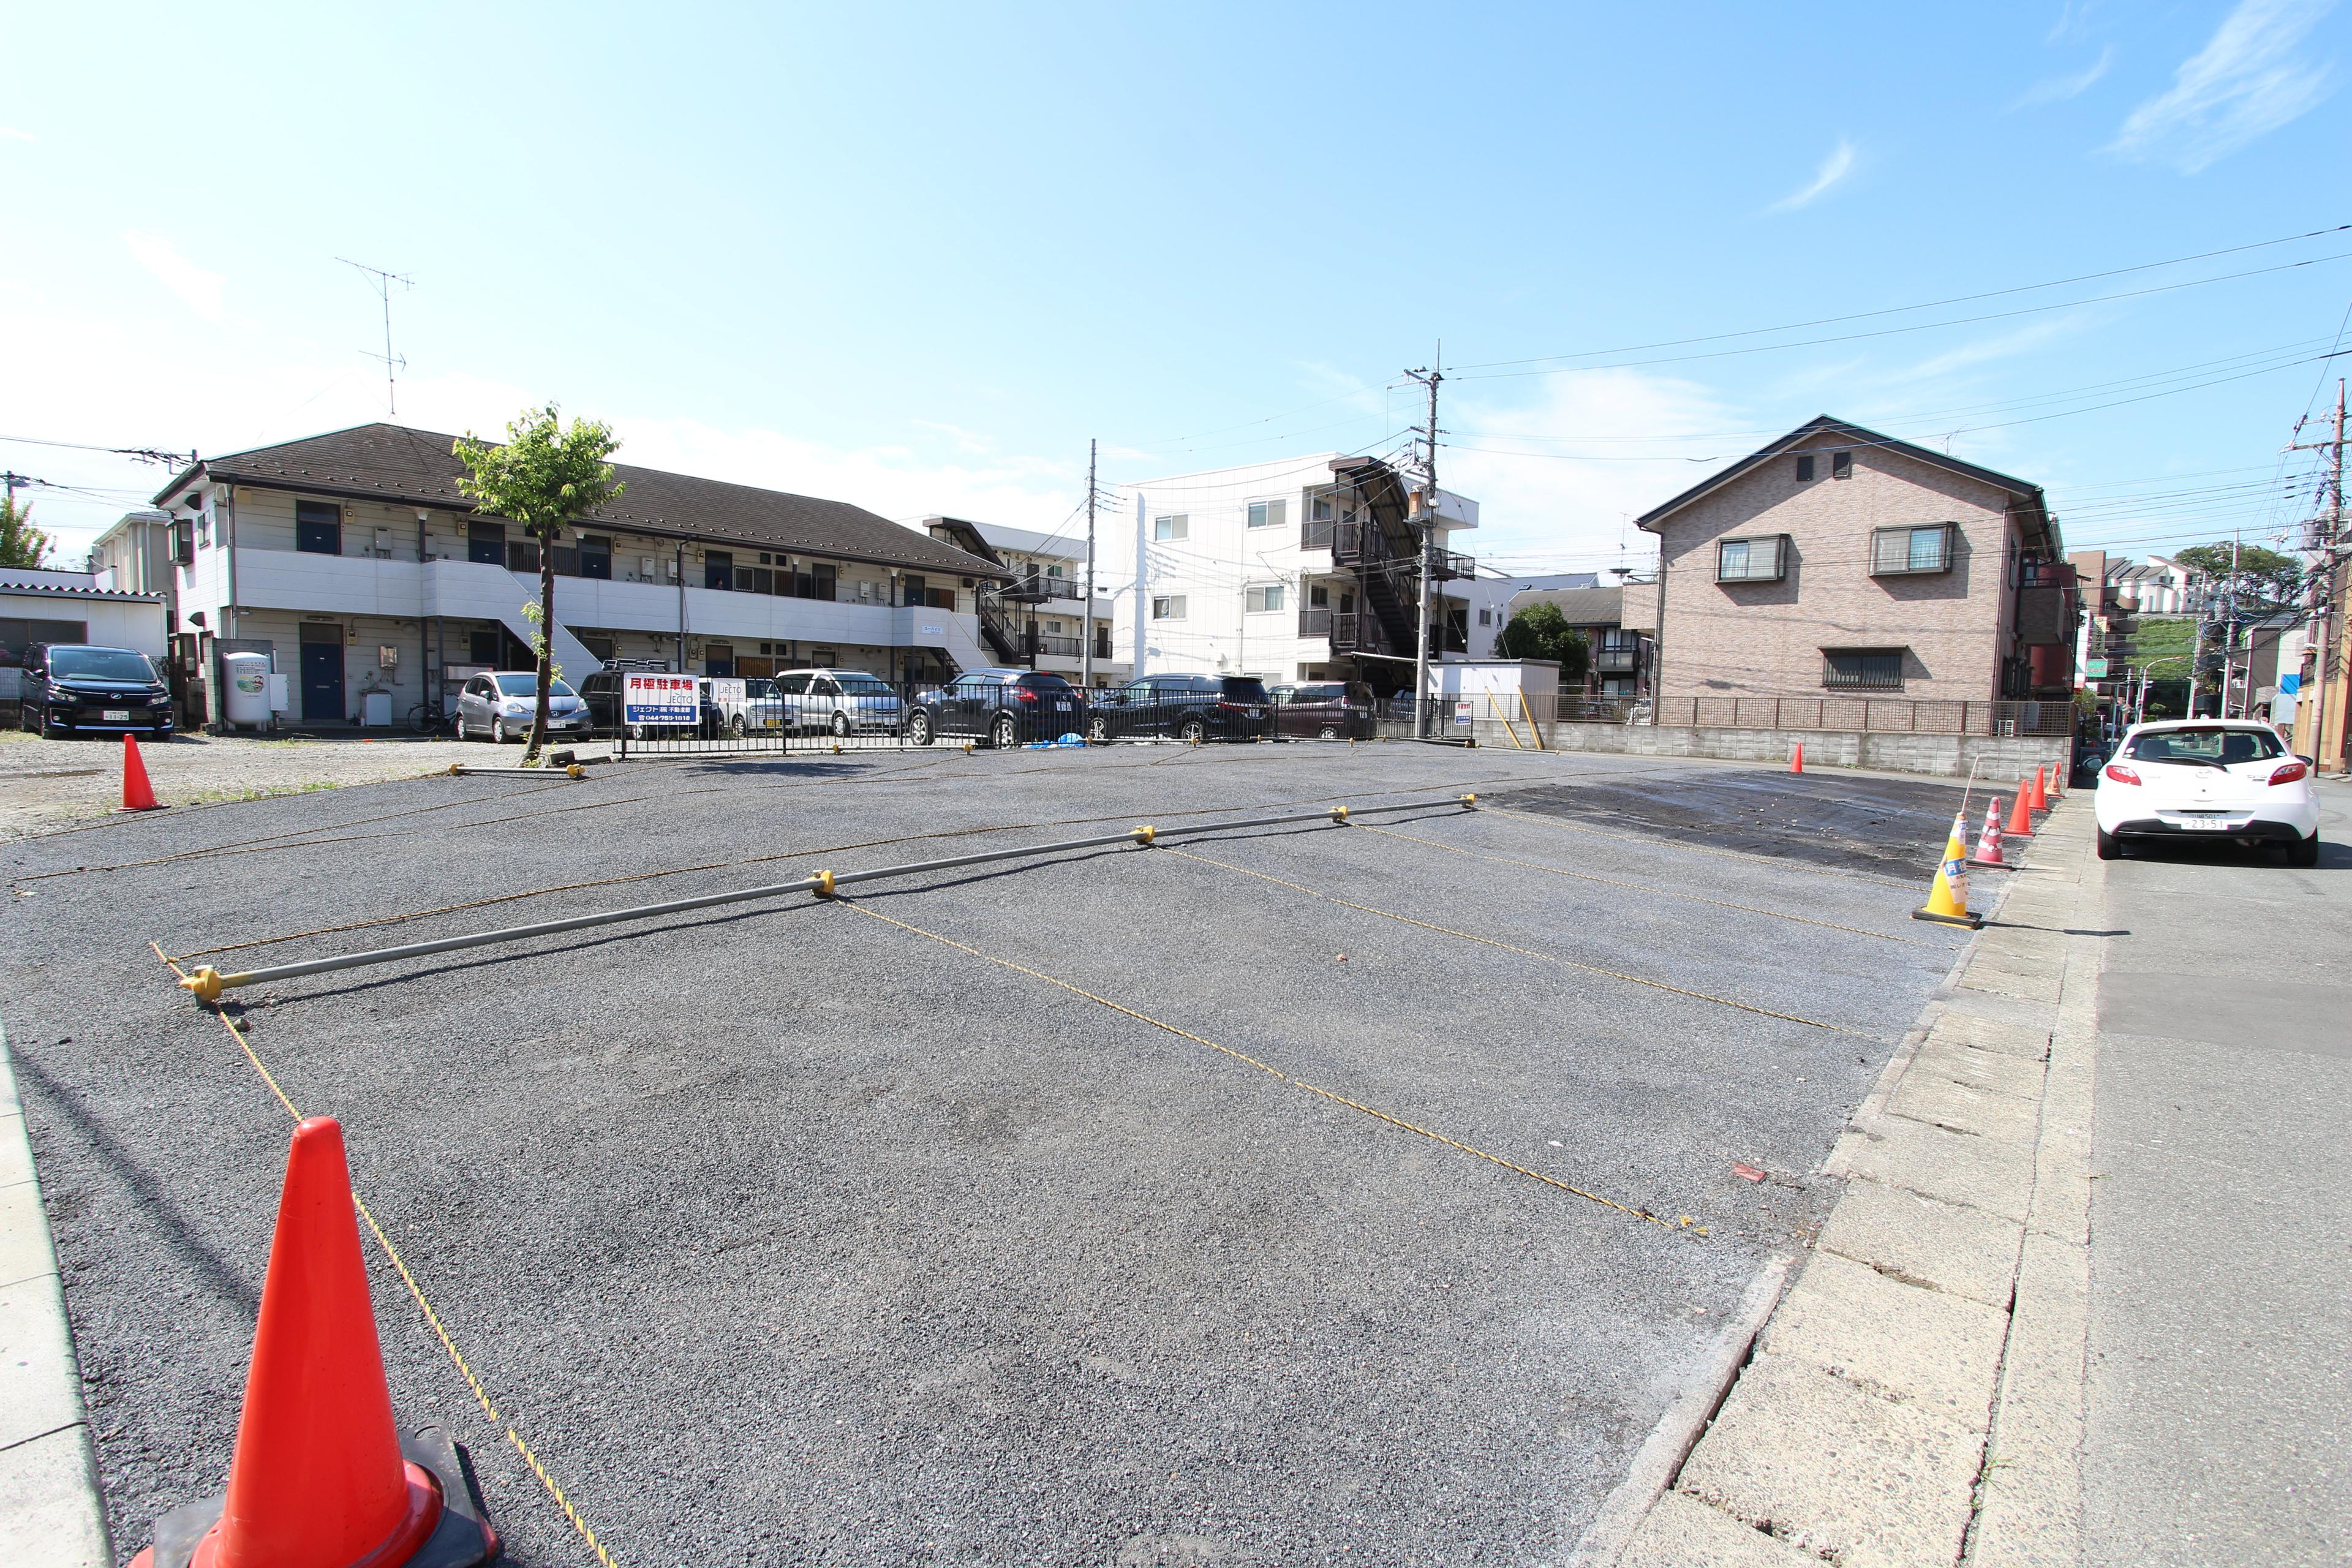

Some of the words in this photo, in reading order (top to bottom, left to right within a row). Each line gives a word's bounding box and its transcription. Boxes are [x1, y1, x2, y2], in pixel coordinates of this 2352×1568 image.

[630, 677, 693, 690] 月極駐車場
[667, 695, 693, 704] JECTO
[2192, 820, 2223, 828] 23-51
